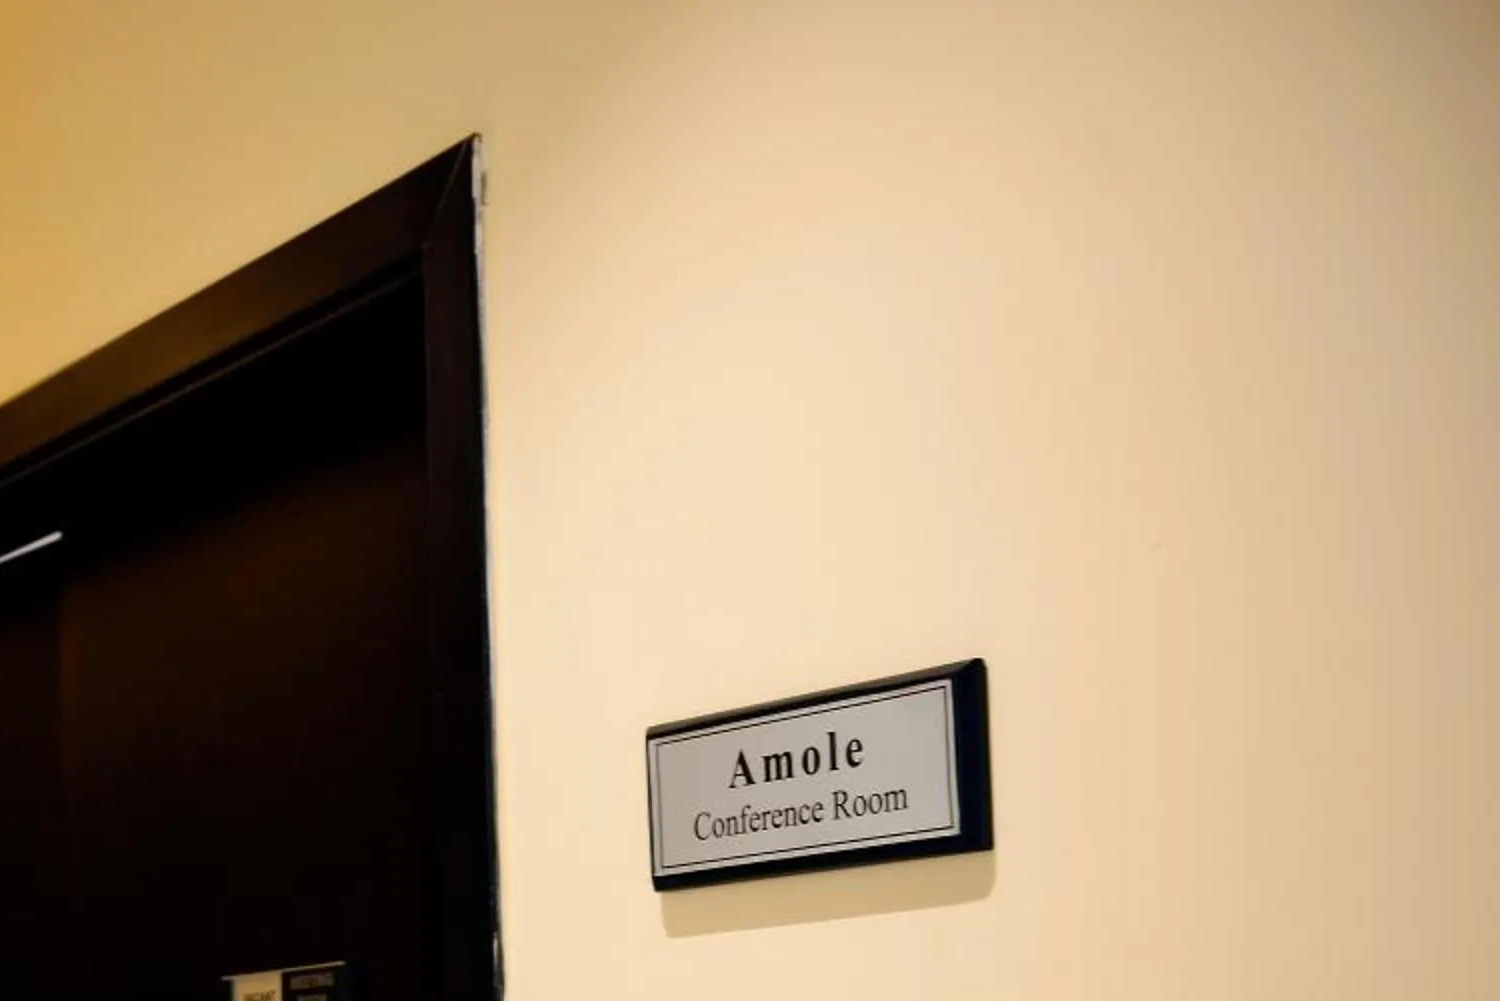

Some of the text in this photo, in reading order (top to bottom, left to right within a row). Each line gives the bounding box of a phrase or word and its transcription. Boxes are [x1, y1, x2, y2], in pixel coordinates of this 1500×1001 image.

[729, 731, 864, 788] Amole
[694, 788, 908, 841] Conference Room
